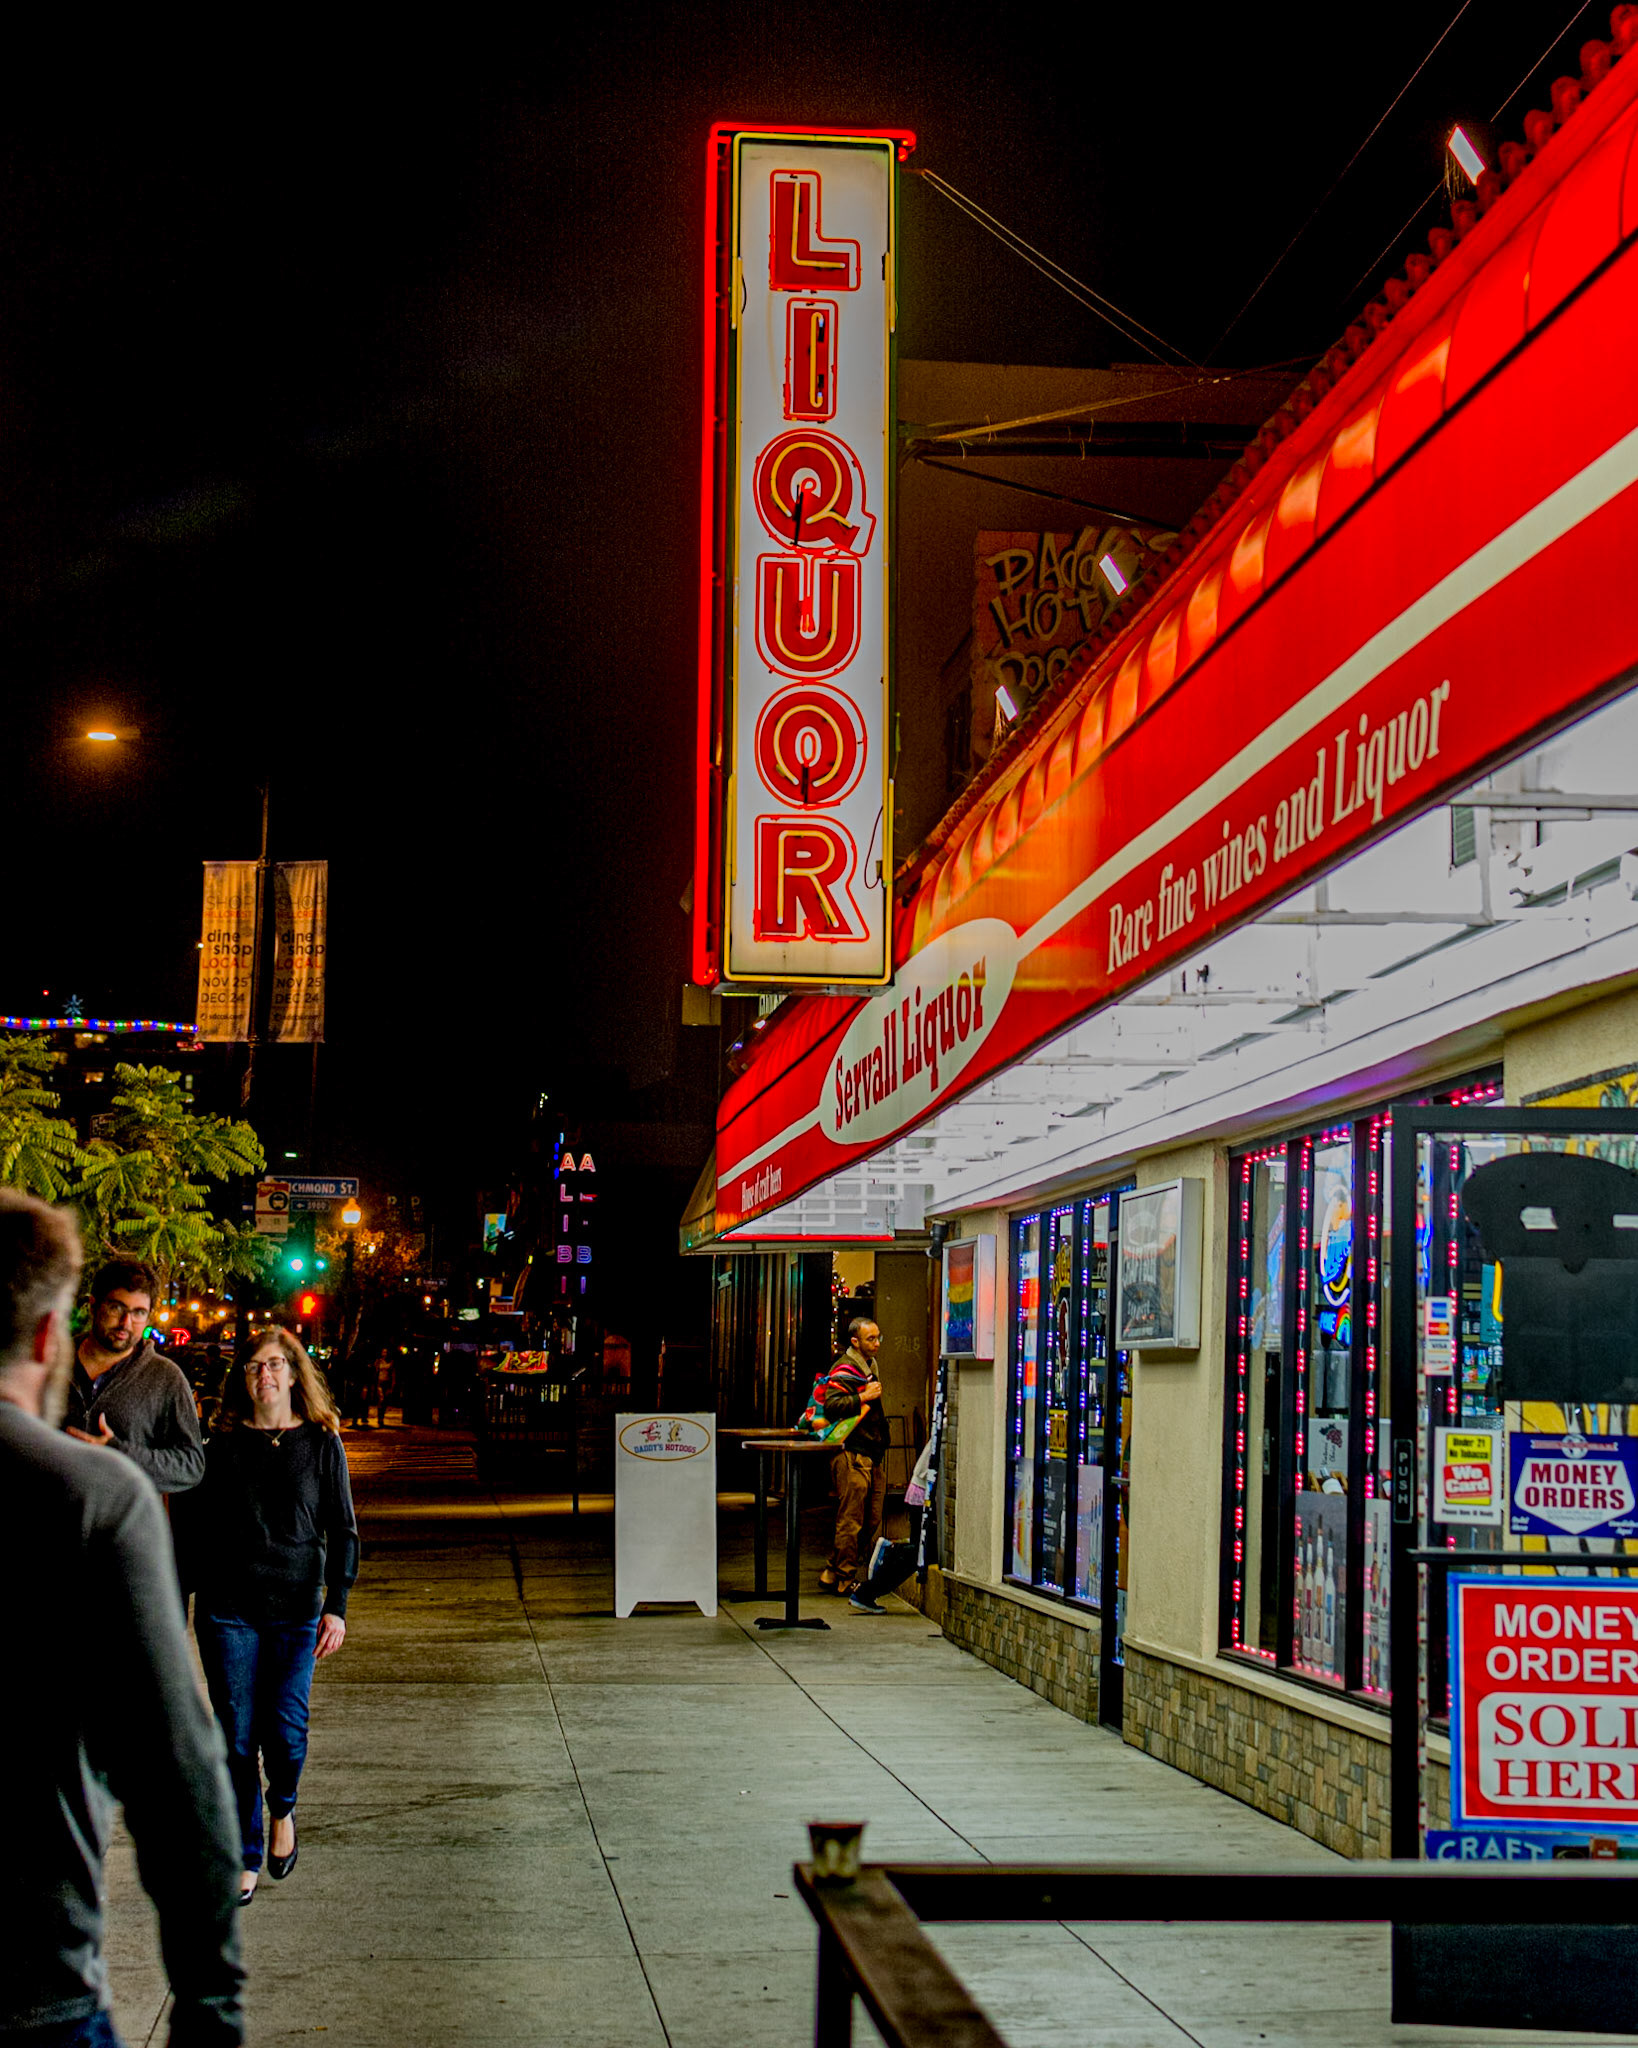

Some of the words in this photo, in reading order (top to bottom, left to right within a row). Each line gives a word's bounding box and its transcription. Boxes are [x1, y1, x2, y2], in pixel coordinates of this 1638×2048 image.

[753, 169, 876, 942] LIQUOR
[1107, 902, 1153, 975] Rare
[1157, 863, 1197, 942] fine
[1203, 820, 1268, 911] wines
[1273, 748, 1326, 863] and
[1332, 680, 1450, 824] Liquor
[206, 896, 253, 910] SHOP
[207, 929, 240, 942] dine
[282, 929, 313, 943] dine
[213, 942, 252, 956] shop
[288, 942, 325, 956] shop
[202, 957, 250, 969] LOCAL
[276, 957, 322, 970] LOCAL
[203, 977, 229, 988] NOV
[233, 977, 248, 987] 25
[277, 977, 303, 988] NOV
[307, 977, 321, 987] 25
[201, 993, 226, 1003] DEC
[230, 993, 245, 1003] 24
[275, 993, 300, 1004] DEC
[306, 993, 320, 1003] 24
[836, 1009, 898, 1132] Servall
[902, 955, 986, 1092] Liquor
[634, 1444, 663, 1453] DADDY'S
[1453, 1438, 1472, 1447] Under
[1477, 1439, 1485, 1447] 21
[1461, 1450, 1488, 1459] Tobacco
[1398, 1452, 1408, 1504] PUSH
[1451, 1466, 1483, 1480] We
[1531, 1463, 1617, 1485] MONEY
[1446, 1477, 1490, 1493] Card
[1525, 1486, 1625, 1510] ORDERS
[1437, 1837, 1544, 1860] CRAFT
